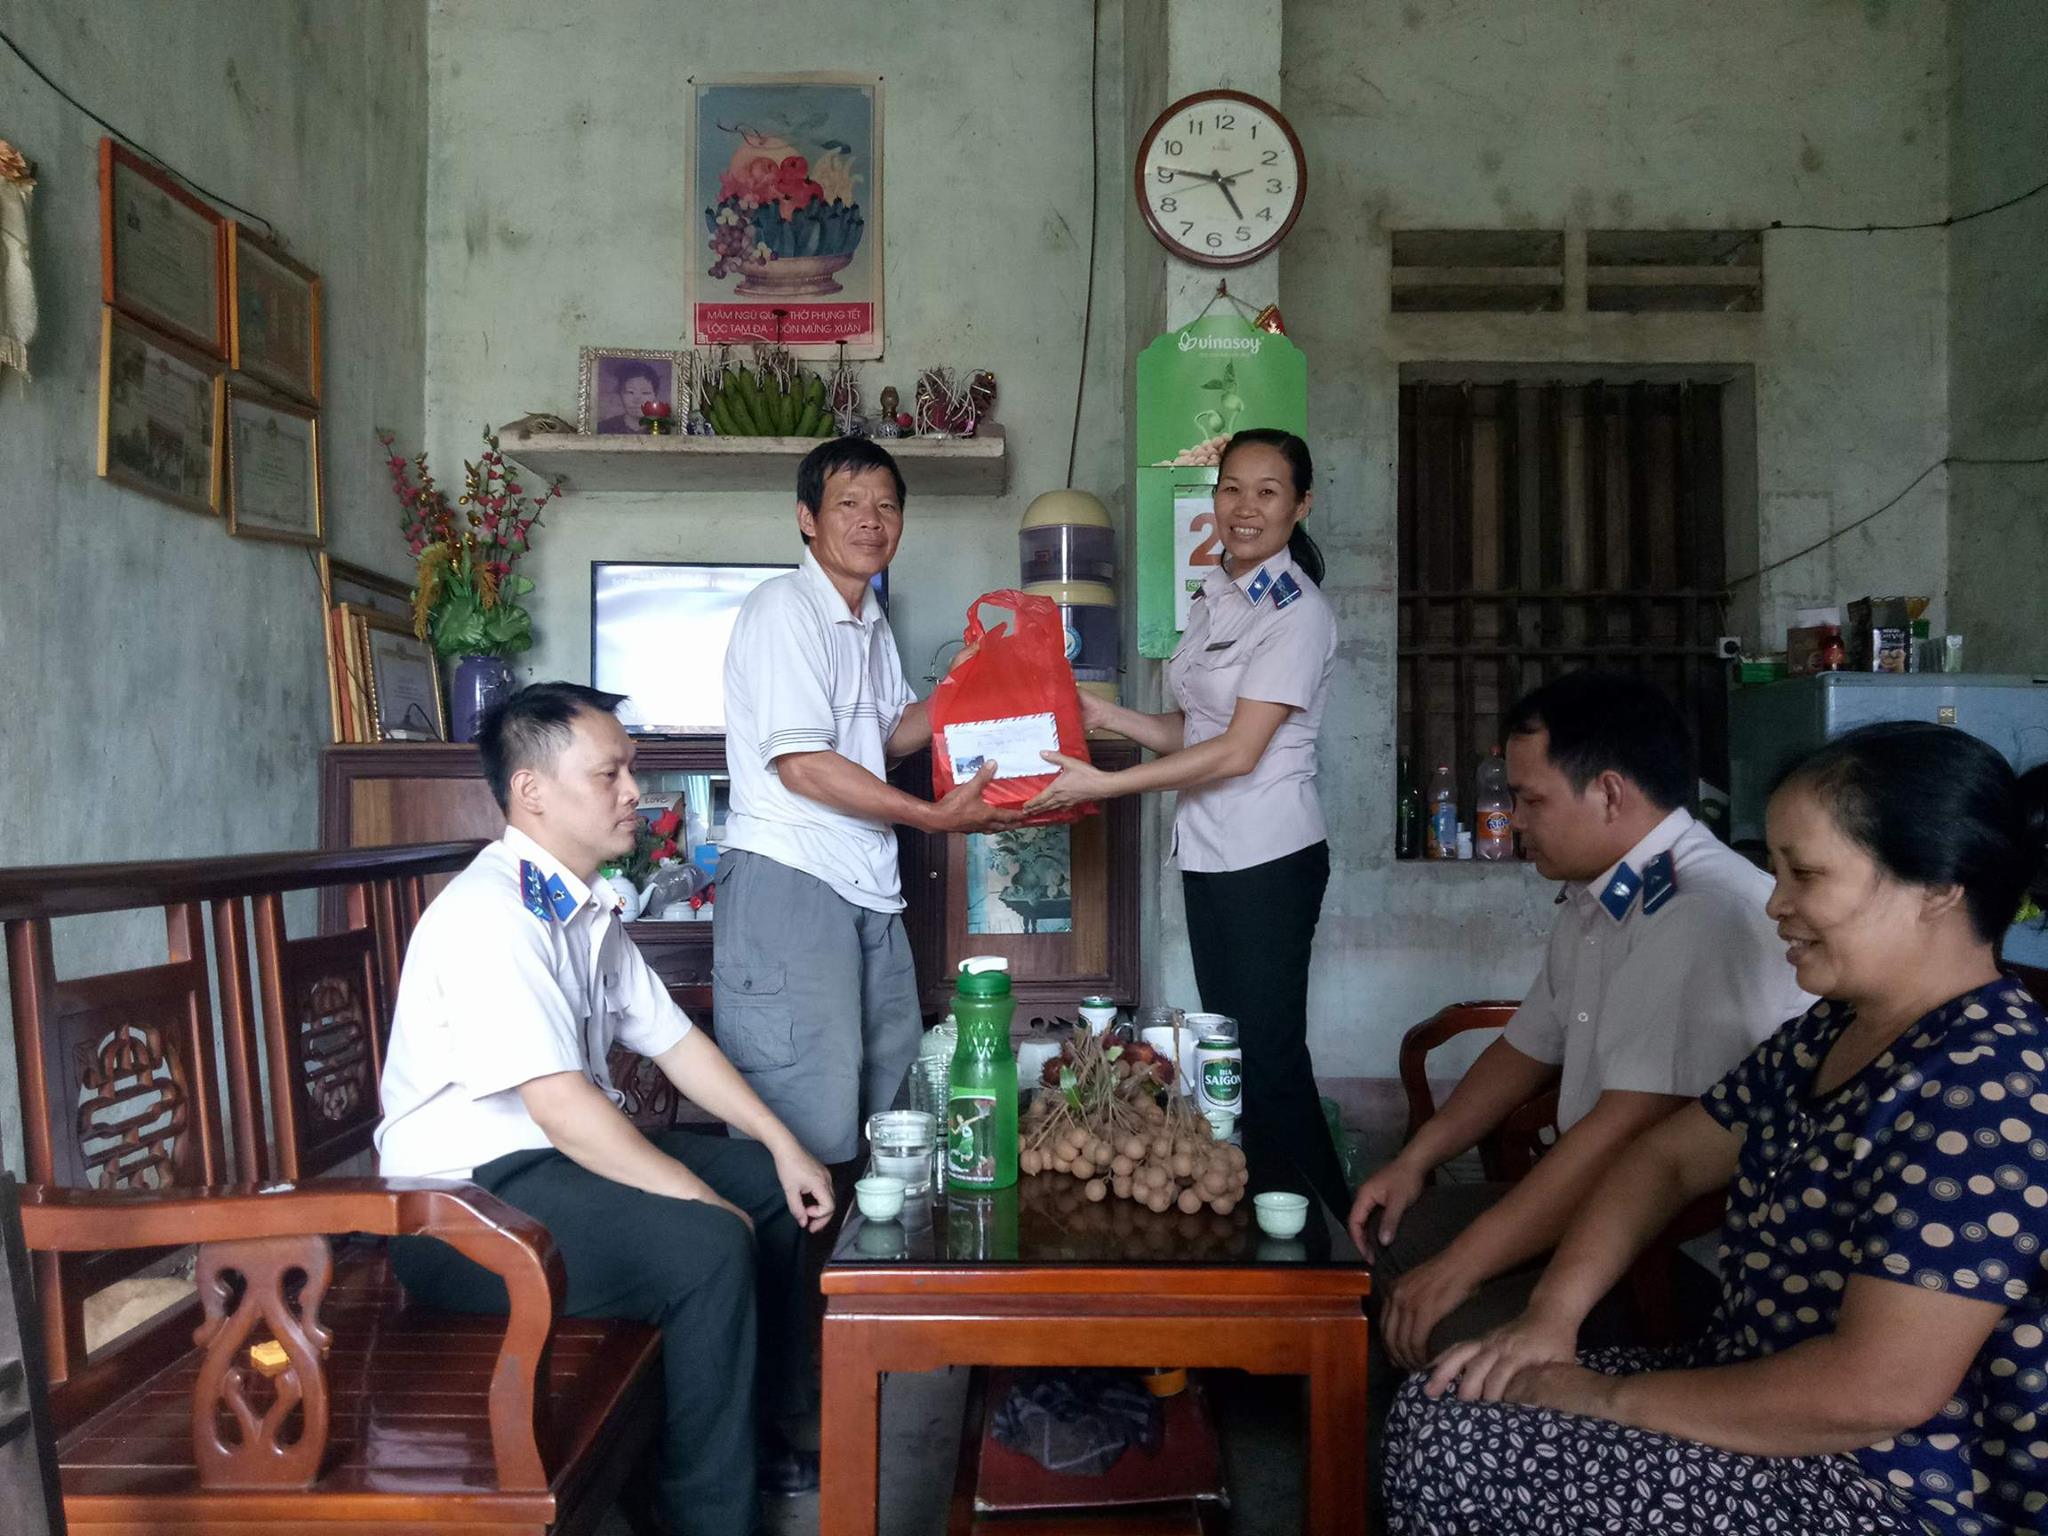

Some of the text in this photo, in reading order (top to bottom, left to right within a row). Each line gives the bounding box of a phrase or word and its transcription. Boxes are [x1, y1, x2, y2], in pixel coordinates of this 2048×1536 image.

[1189, 120, 1203, 136] 11
[1215, 115, 1235, 130] 12
[1250, 125, 1257, 140] 1
[1164, 140, 1183, 156] 10
[1262, 151, 1278, 166] 2
[1158, 169, 1174, 184] 9
[1266, 178, 1282, 194] 3
[1160, 198, 1177, 213] 8
[1256, 207, 1272, 222] 4
[1180, 221, 1194, 236] 7
[1236, 226, 1251, 242] 5
[1206, 232, 1222, 248] 6
[848, 308, 861, 320] TẾT
[707, 322, 728, 334] LỘC
[1199, 334, 1260, 354] vinasoy
